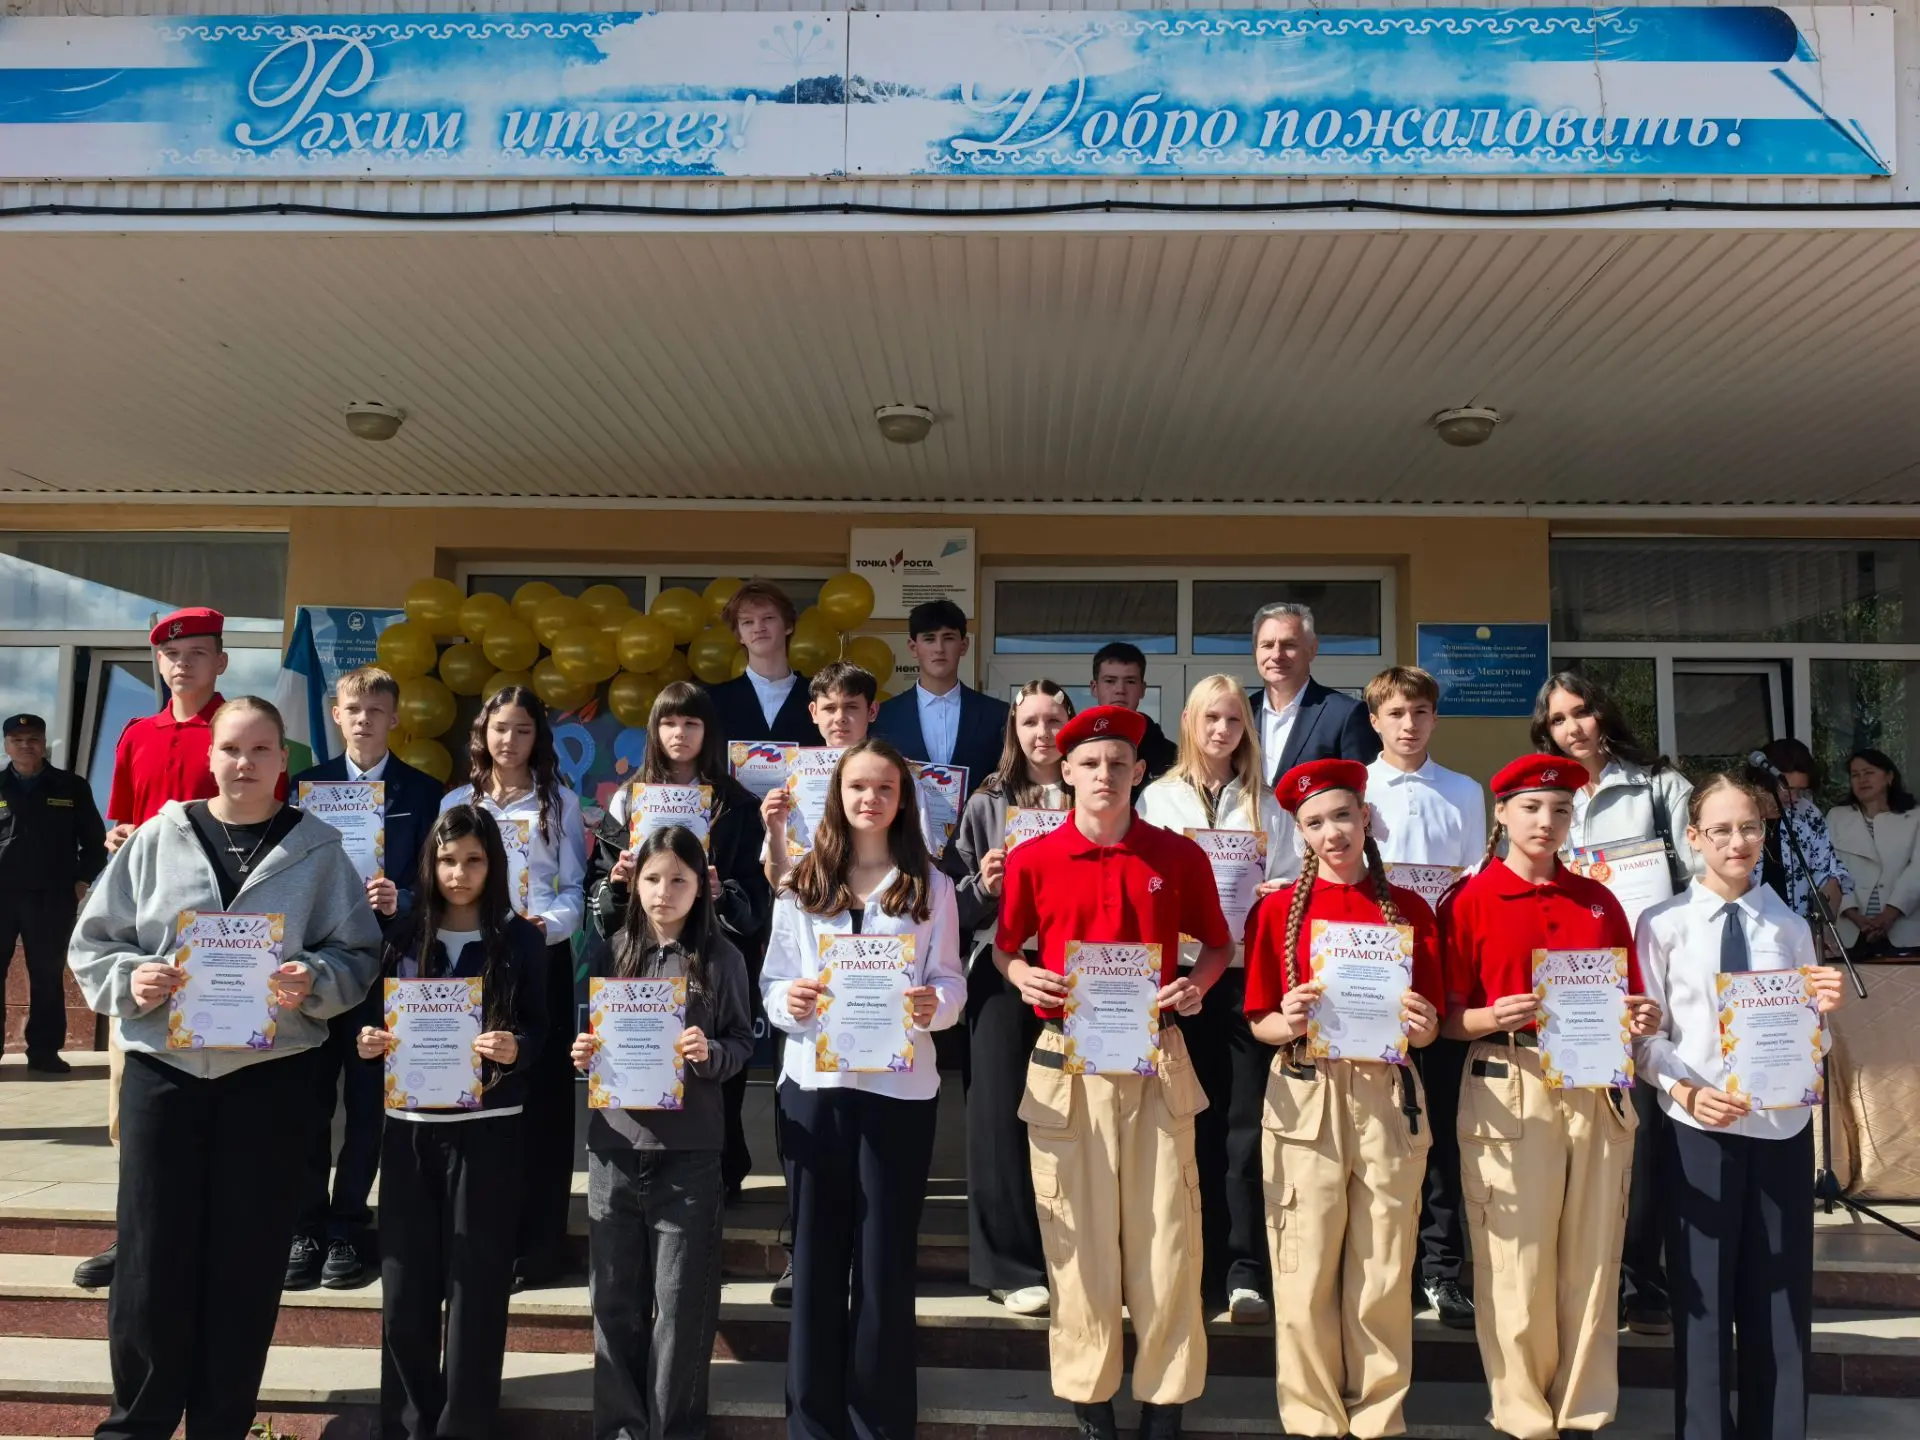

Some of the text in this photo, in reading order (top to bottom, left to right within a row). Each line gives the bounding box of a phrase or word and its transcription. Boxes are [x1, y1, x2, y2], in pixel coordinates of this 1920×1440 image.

[235, 30, 757, 150] Рәхим итегез!
[951, 32, 1743, 165] Добро пожаловать!
[804, 767, 834, 776] ГРАМ
[319, 803, 368, 812] ГРАМОТА
[649, 804, 696, 814] ГРАМОТА
[1023, 828, 1051, 837] ГРАМ
[1207, 851, 1251, 861] РАМОТА
[1619, 858, 1660, 872] ГРАМОТА
[200, 938, 263, 949] ГРАМОТА
[1334, 947, 1394, 962] ГРАМОТА
[840, 960, 897, 970] ГРАМОТА
[1086, 966, 1143, 977] ГРАМОТА
[1554, 974, 1610, 985] ГРАМОТА
[1741, 995, 1800, 1009] ГРАМОТА
[406, 1003, 465, 1013] ГРАМОТА
[611, 1003, 668, 1013] ГРАМОТА
